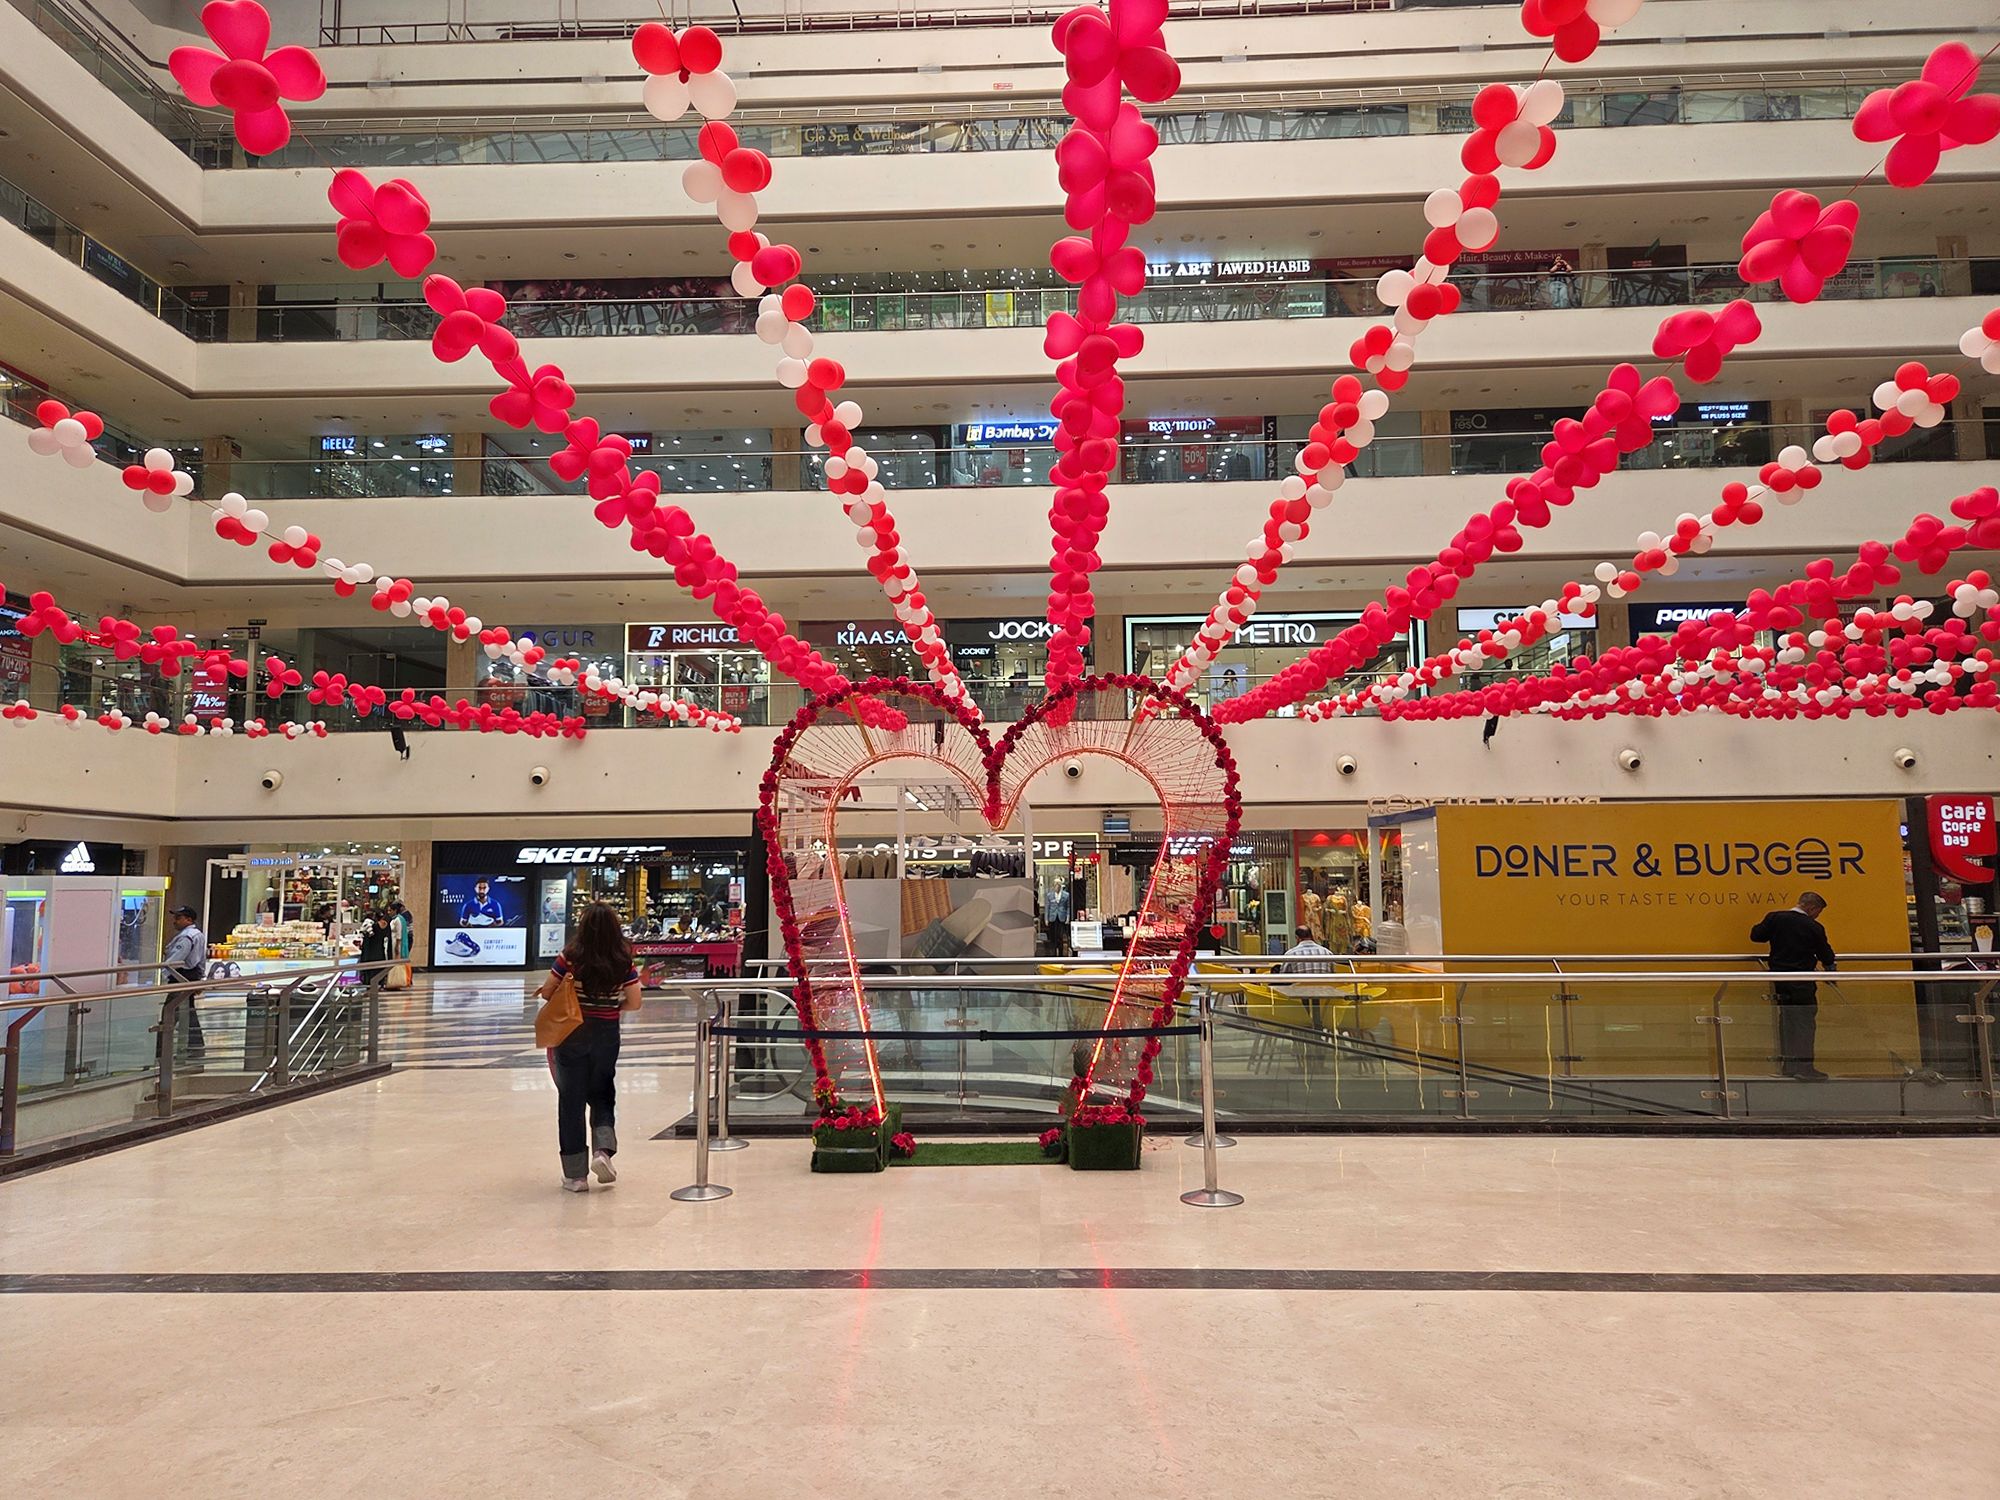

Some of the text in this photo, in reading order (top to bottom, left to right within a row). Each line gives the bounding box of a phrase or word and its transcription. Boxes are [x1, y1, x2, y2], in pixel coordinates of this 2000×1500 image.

[805, 127, 825, 142] Glo
[829, 127, 850, 147] Spa
[853, 127, 864, 141] &
[1459, 253, 1480, 264] Hair,
[1482, 252, 1512, 265] Beauty
[1513, 252, 1522, 261] &
[1143, 262, 1213, 278] AIL ART
[1217, 259, 1311, 277] JAWED HABIB
[984, 424, 1036, 441] Bombay
[322, 437, 355, 450] HEELZ
[1184, 451, 1205, 464] 50%
[1234, 622, 1316, 645] METRO
[958, 647, 991, 656] JOCKEY
[1943, 834, 1969, 847] Day
[1475, 837, 1866, 880] DONER & BURGER
[1557, 891, 1789, 906] YOUR TASTE YOUR WAY
